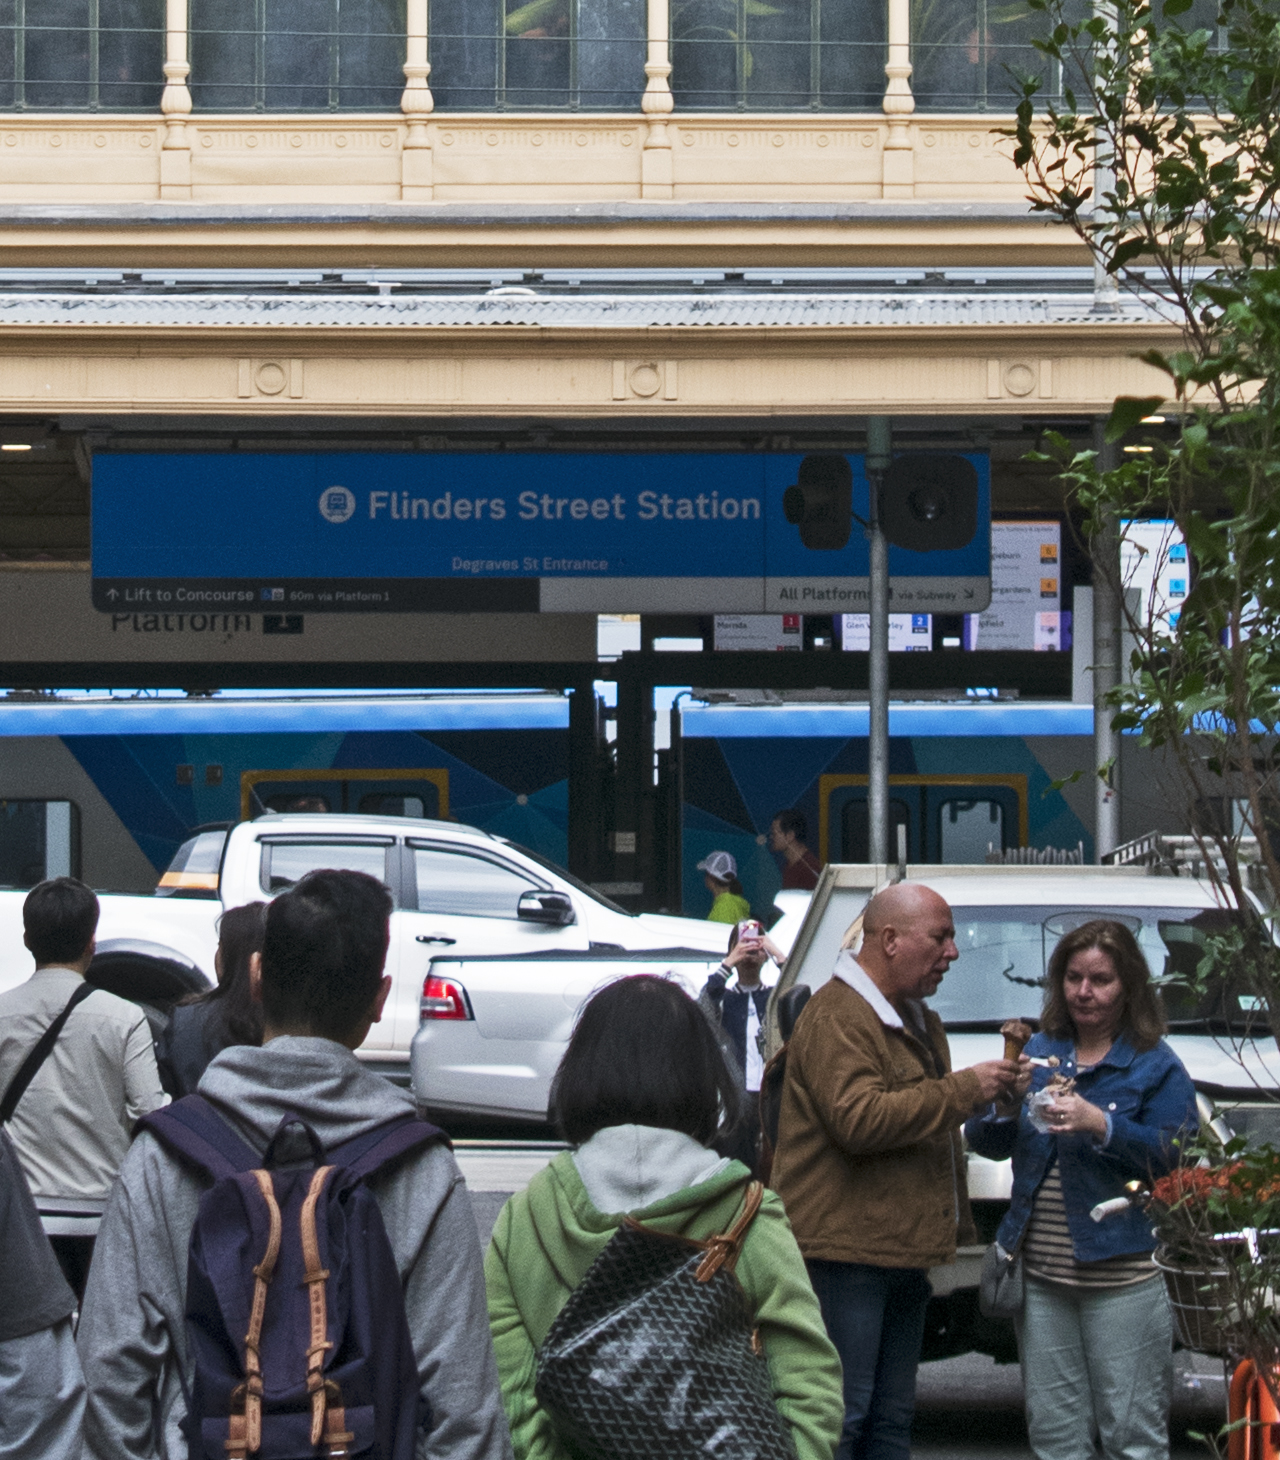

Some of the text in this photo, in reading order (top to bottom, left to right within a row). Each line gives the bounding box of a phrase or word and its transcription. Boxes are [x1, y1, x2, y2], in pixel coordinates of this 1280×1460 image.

[368, 490, 762, 521] Flinders Street Station
[452, 557, 609, 574] Degraves St Entrance
[125, 588, 152, 602] Lift
[156, 588, 172, 602] to
[176, 588, 254, 602] Concourse
[335, 592, 383, 602] Platform
[779, 587, 798, 600] All
